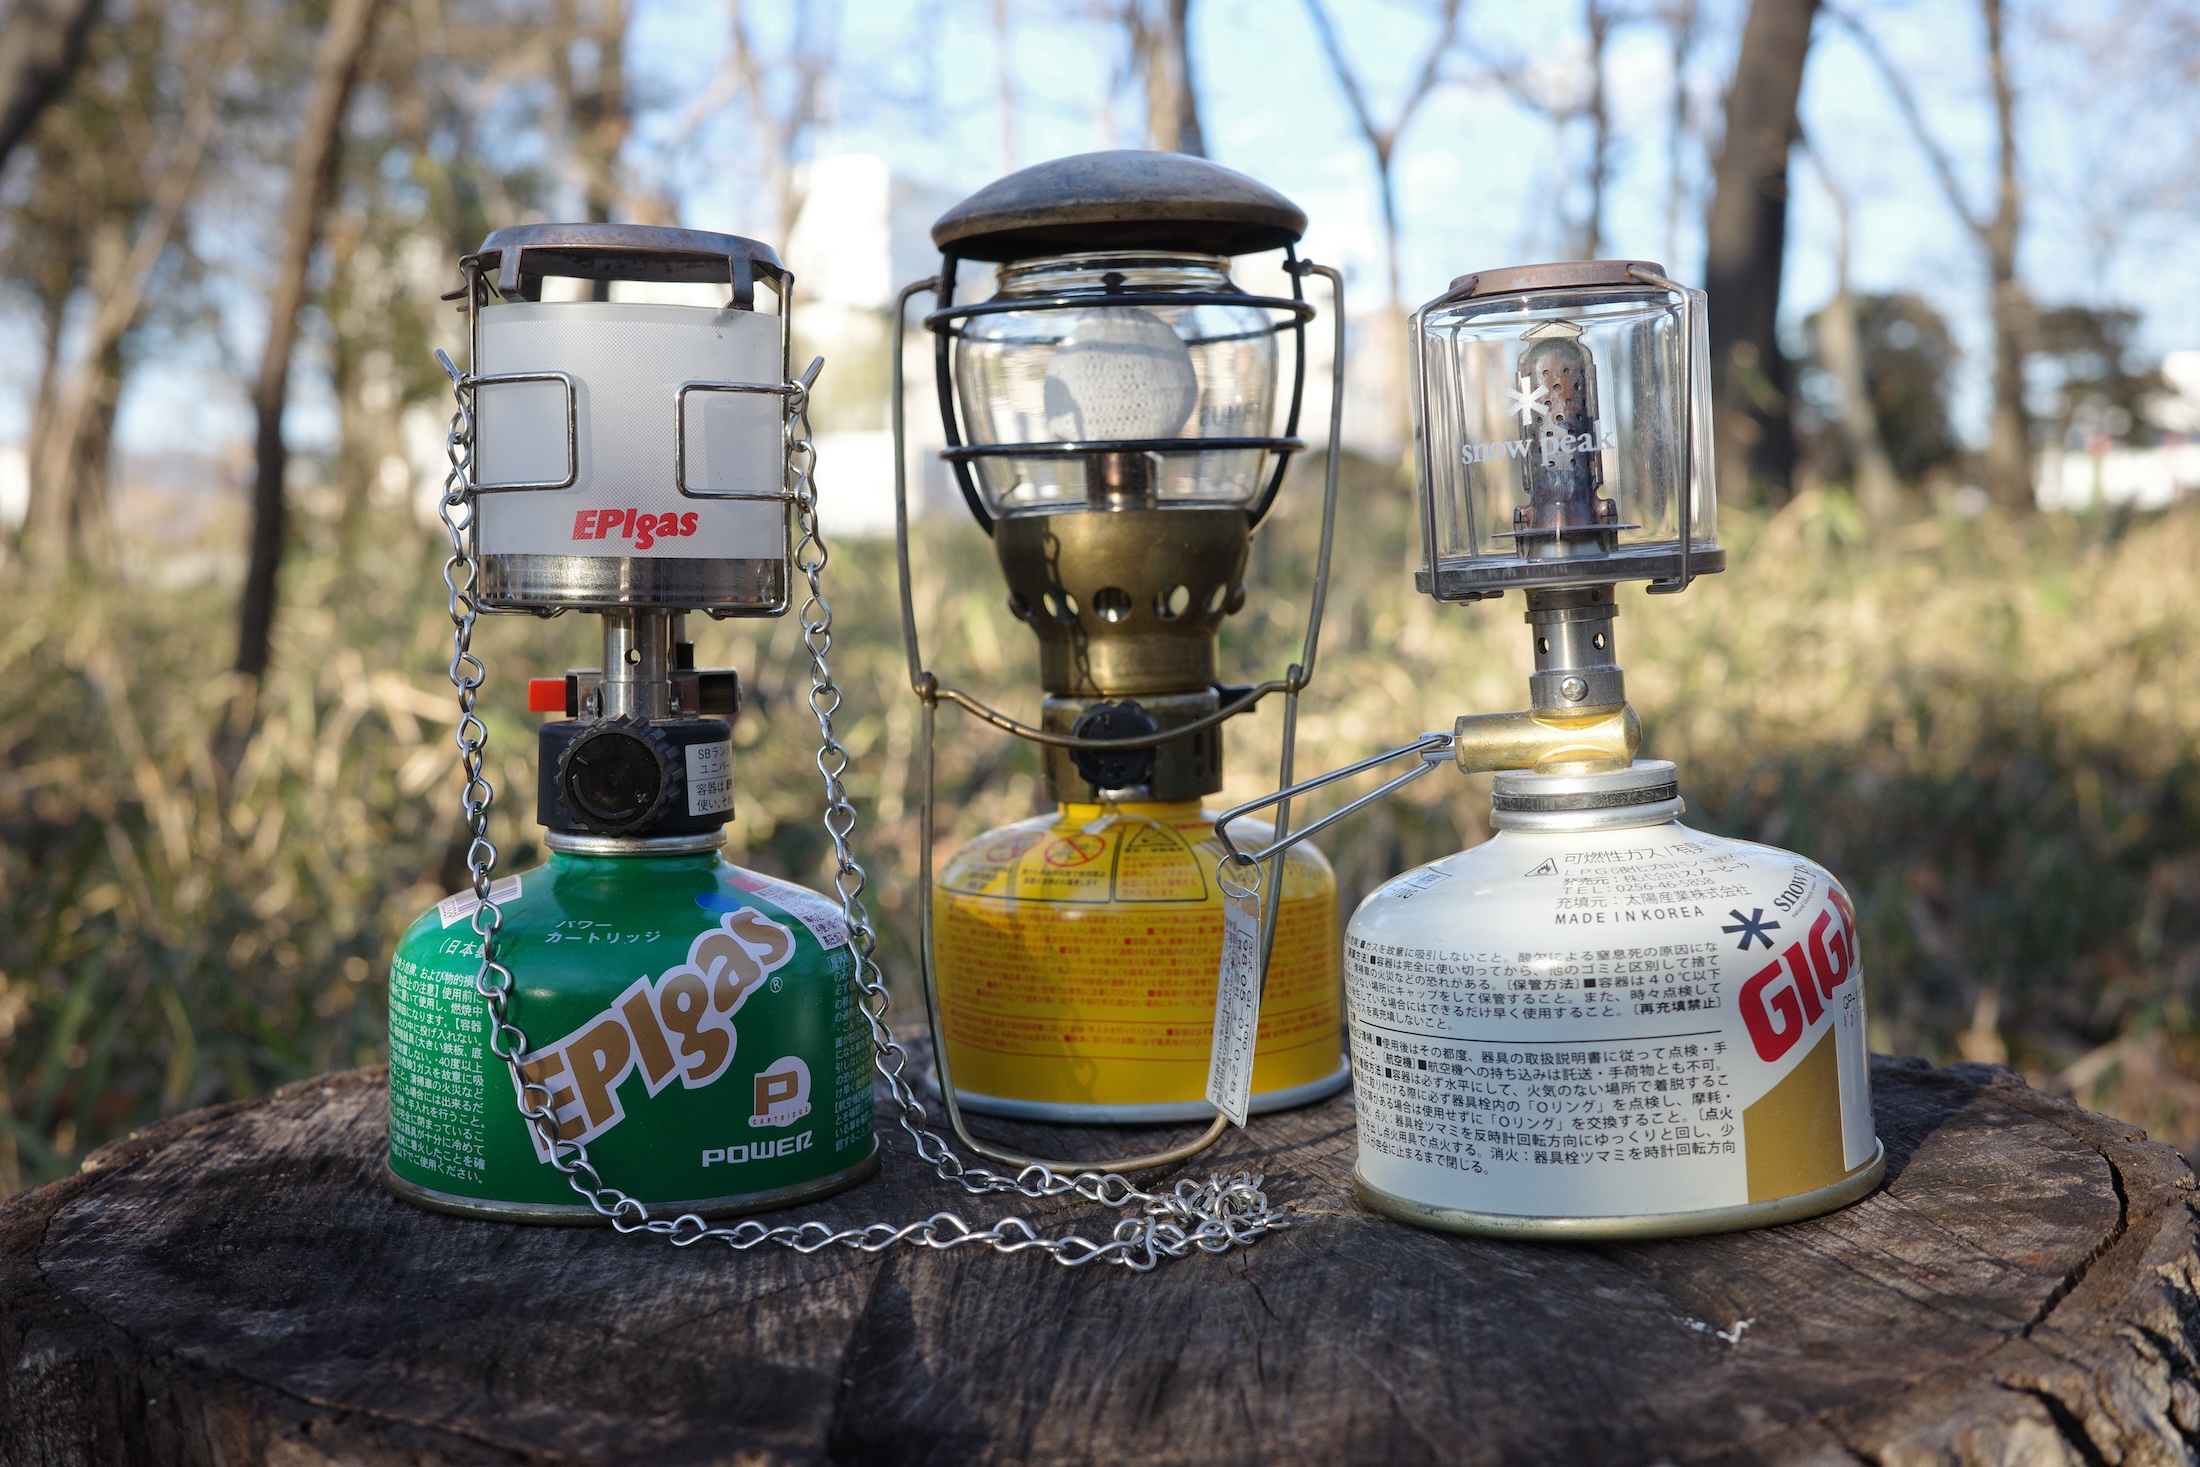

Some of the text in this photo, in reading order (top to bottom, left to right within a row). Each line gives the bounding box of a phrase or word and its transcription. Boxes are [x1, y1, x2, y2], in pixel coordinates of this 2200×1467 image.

[1461, 419, 1616, 467] snow peak
[572, 508, 699, 550] EPIgas
[1773, 873, 1809, 913] snow
[545, 931, 661, 944] カートリッジ
[555, 920, 613, 930] パワー
[1555, 912, 1606, 926] MADE
[511, 906, 796, 1164] EPIgas
[752, 1105, 809, 1126] CARTRIDGE
[702, 1130, 814, 1168] POWER
